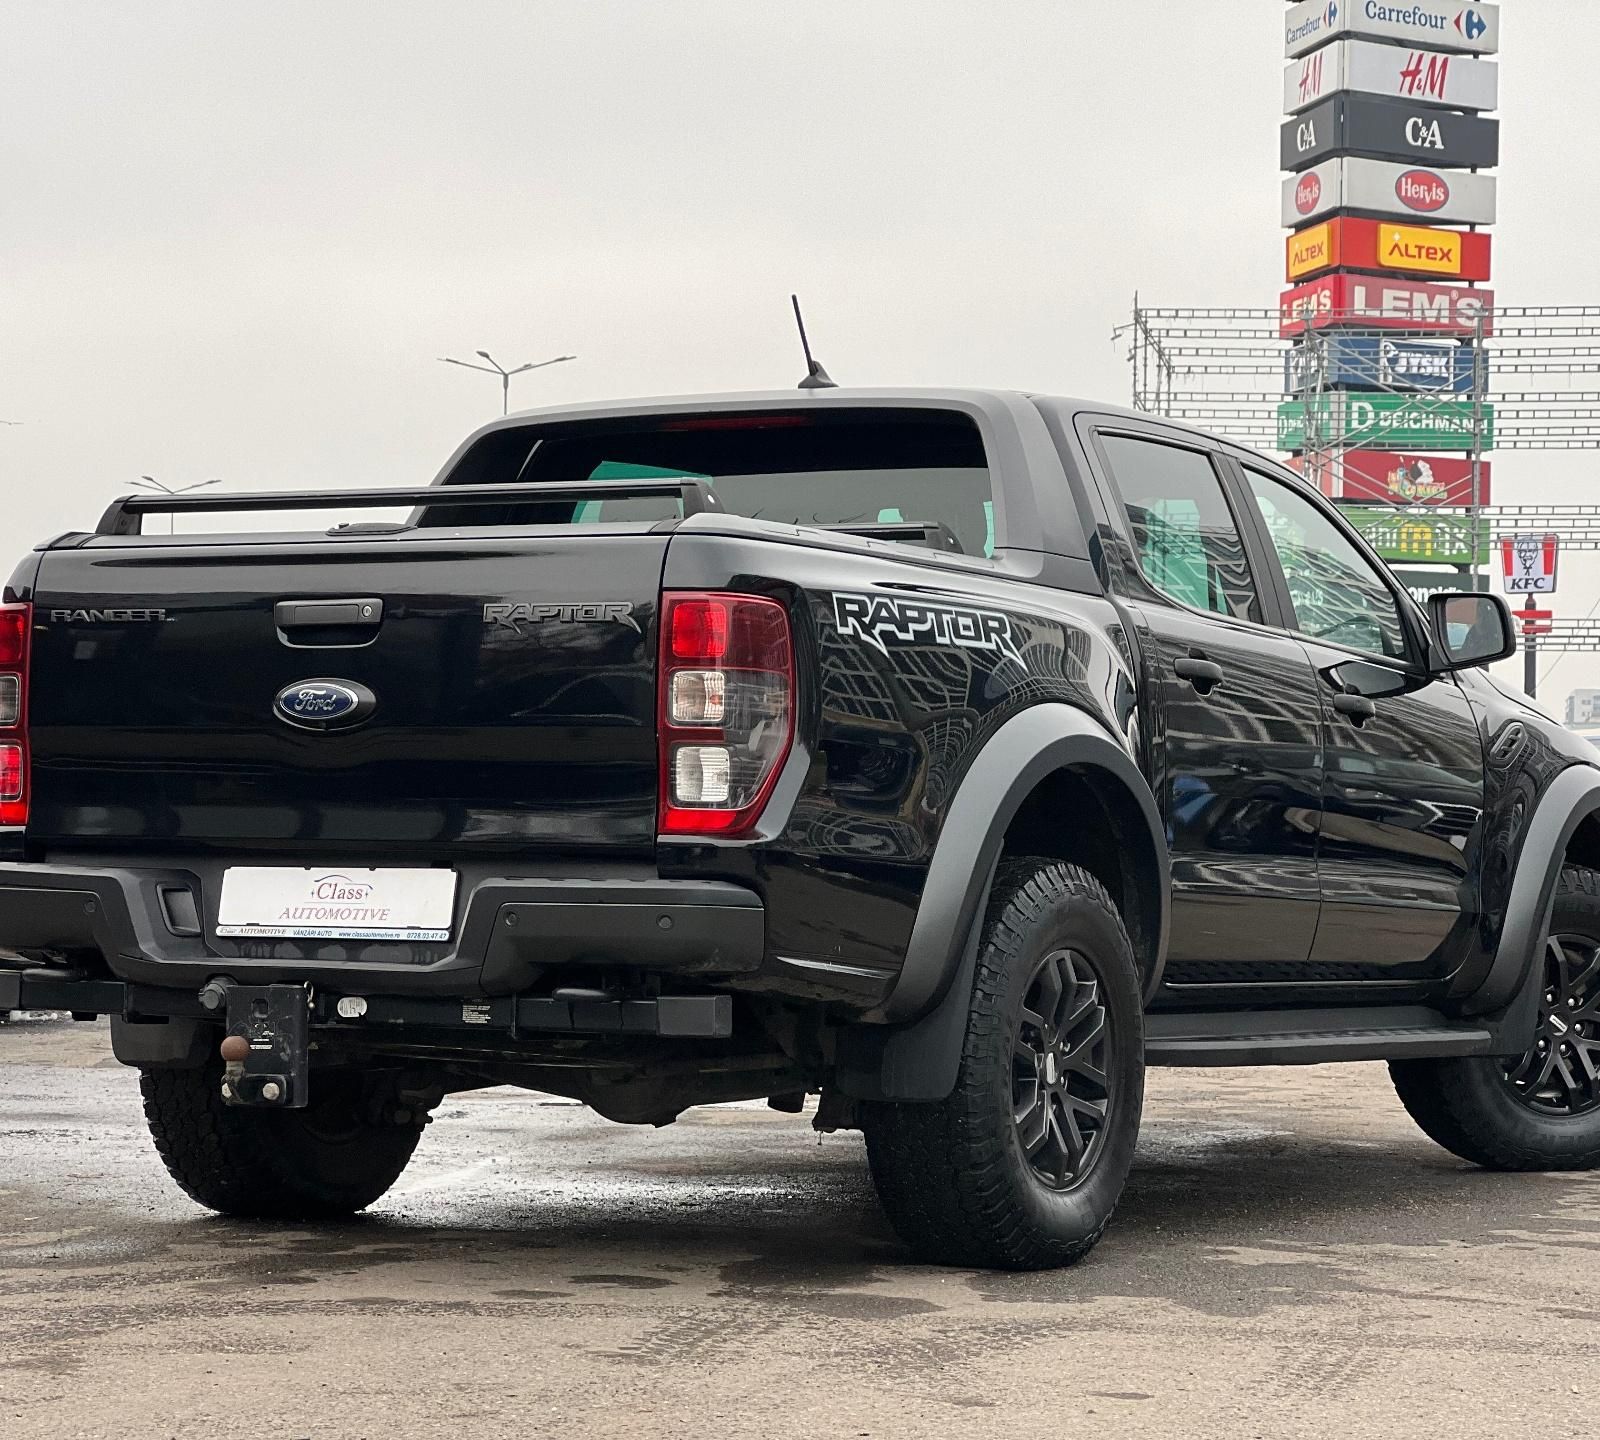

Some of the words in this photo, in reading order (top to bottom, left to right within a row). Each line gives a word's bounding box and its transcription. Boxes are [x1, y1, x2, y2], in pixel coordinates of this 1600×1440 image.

[1365, 1, 1447, 30] Carrefour
[1286, 16, 1321, 45] Carrefour
[1299, 51, 1324, 104] H&M
[1400, 51, 1449, 100] H&M
[1297, 119, 1317, 152] C&A
[1405, 117, 1445, 150] C&A
[1297, 183, 1319, 206] Hervis
[1401, 177, 1446, 204] Hervis
[1394, 352, 1449, 378] JYSK
[1379, 410, 1489, 435] DEICHMANN
[1510, 577, 1546, 590] KFC
[50, 608, 166, 623] RANGER
[483, 601, 642, 635] RAPTOR
[831, 591, 1028, 674] RAPTOR
[294, 689, 337, 711] Ford
[317, 882, 363, 900] Class
[278, 907, 391, 921] AUTOMOTIVE
[238, 927, 287, 935] AUTOMOTIVE
